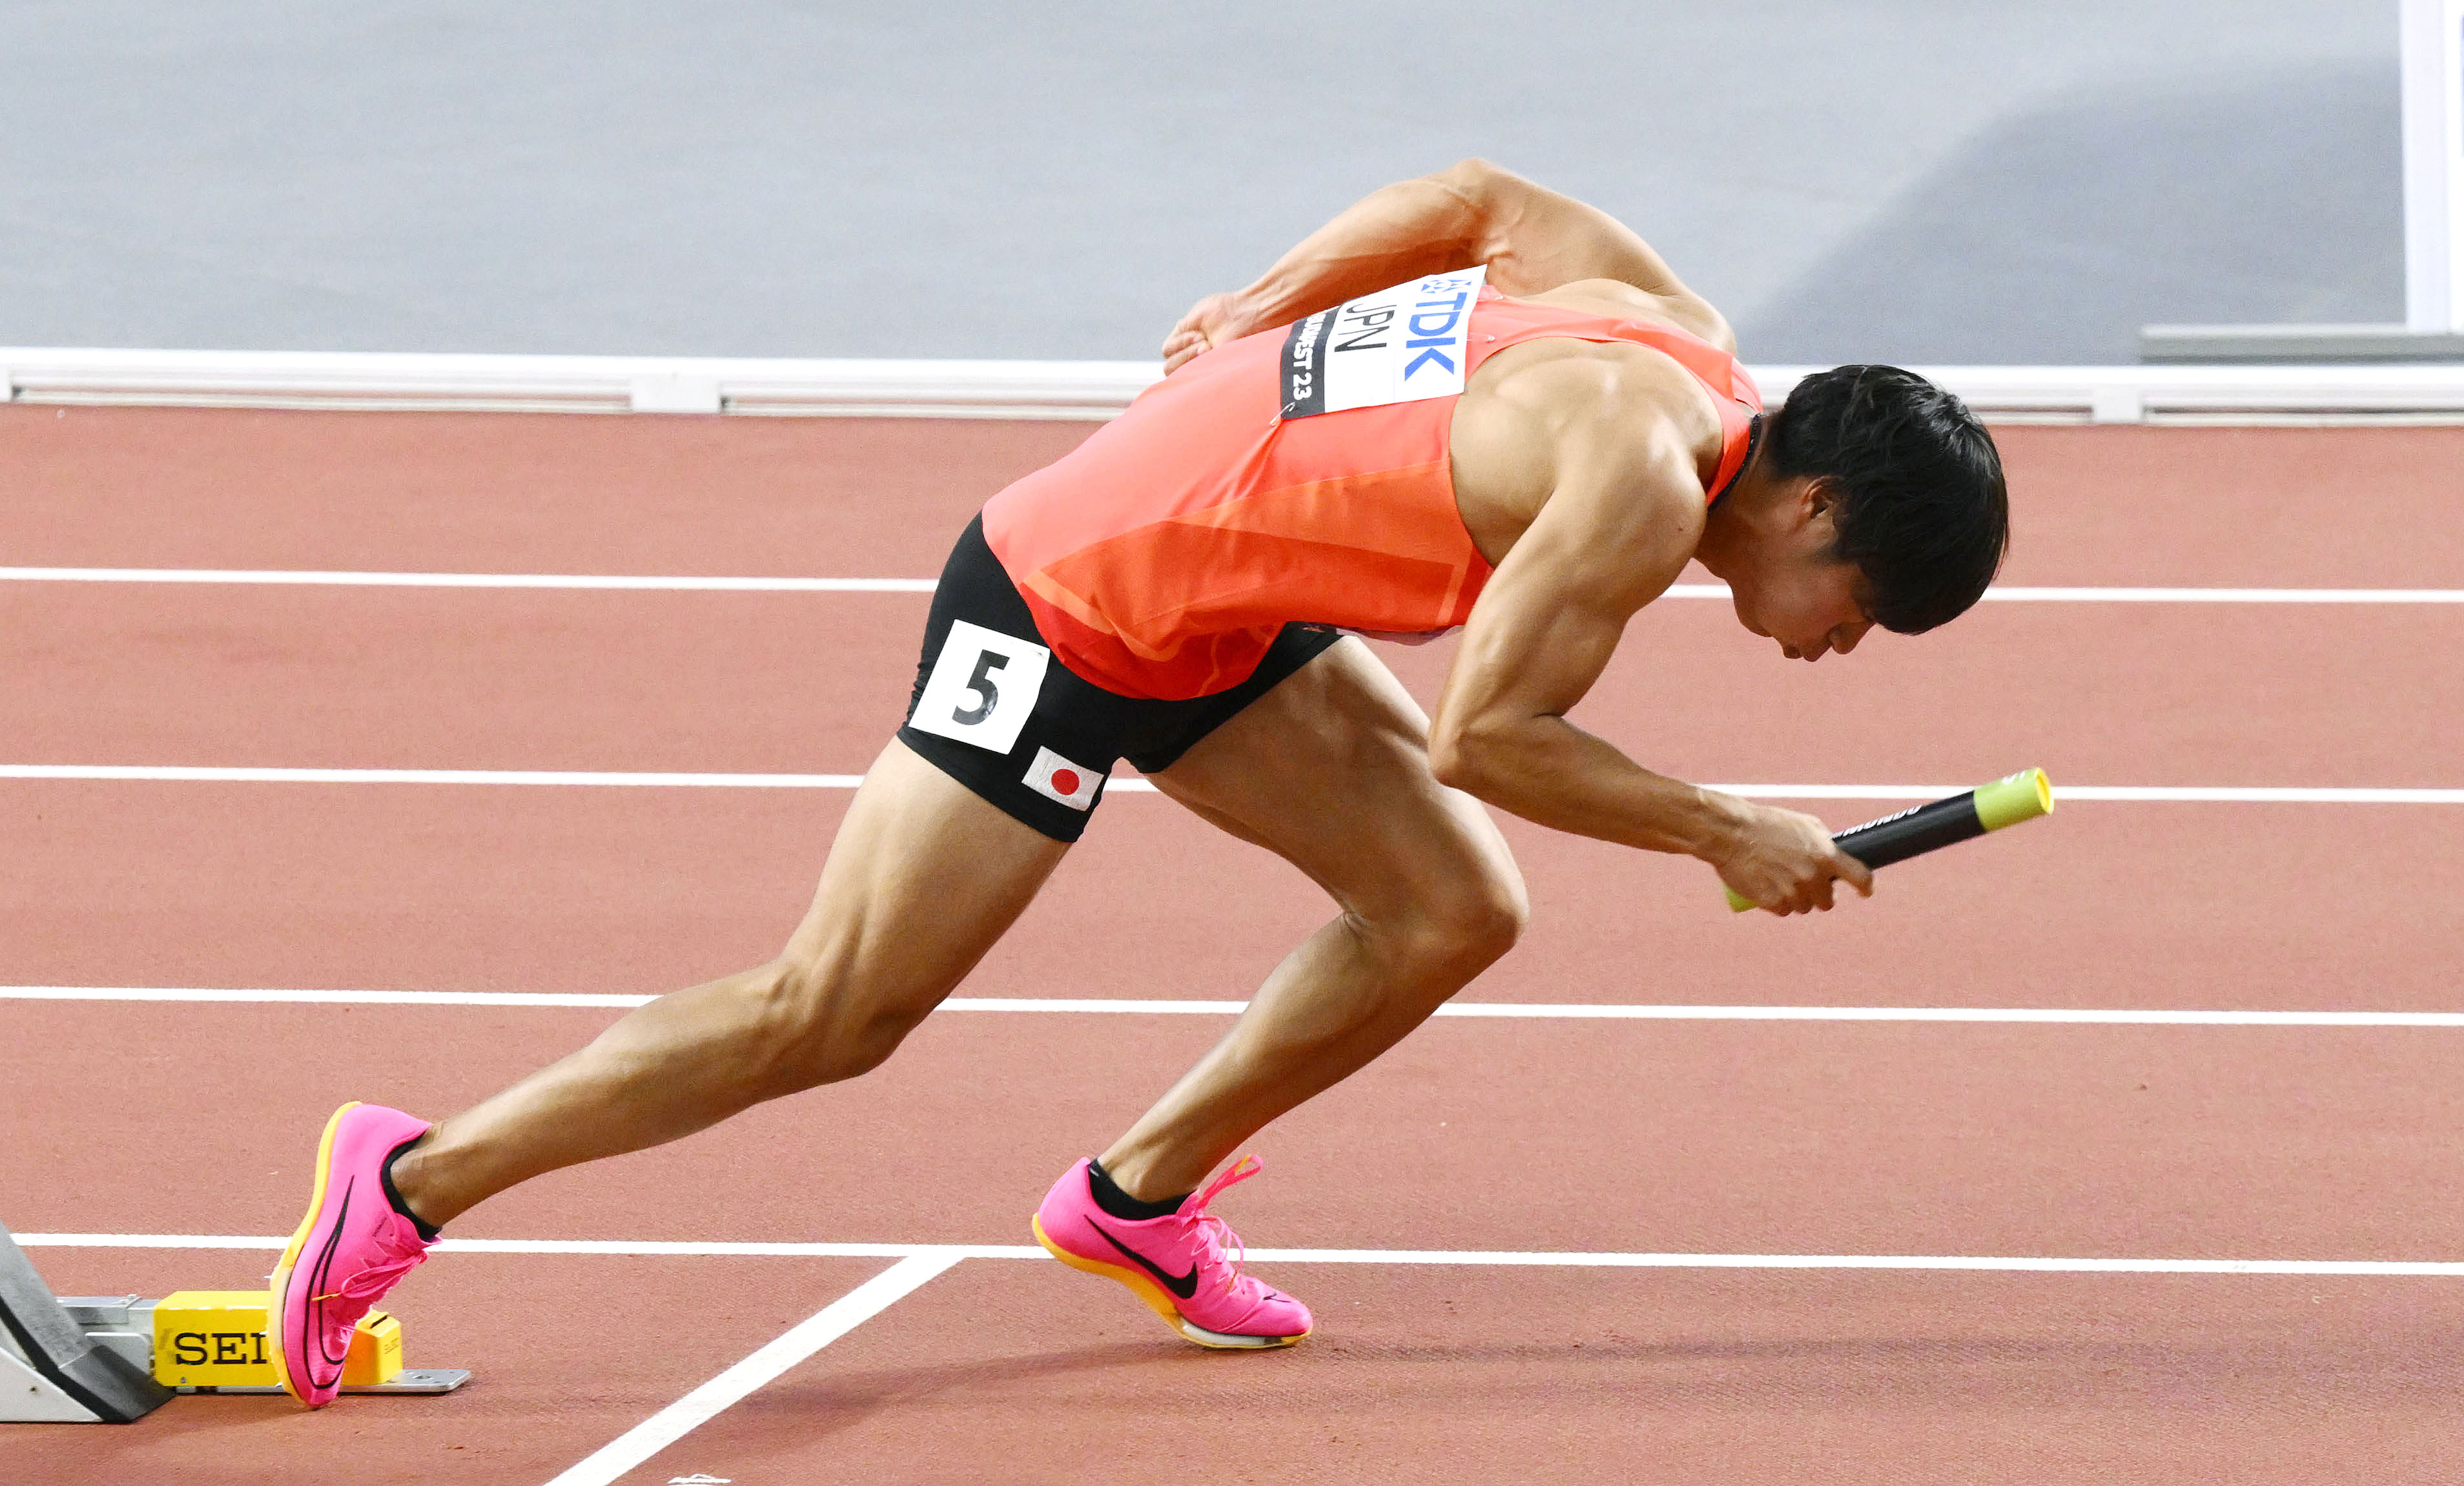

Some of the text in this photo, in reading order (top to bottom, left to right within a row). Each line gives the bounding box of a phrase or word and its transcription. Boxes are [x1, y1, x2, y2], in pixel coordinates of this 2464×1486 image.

[1334, 304, 1397, 352] JPN
[1404, 292, 1468, 382] TDK
[1293, 371, 1313, 400] 23
[952, 649, 1010, 725] 5
[175, 1332, 267, 1365] SEI
